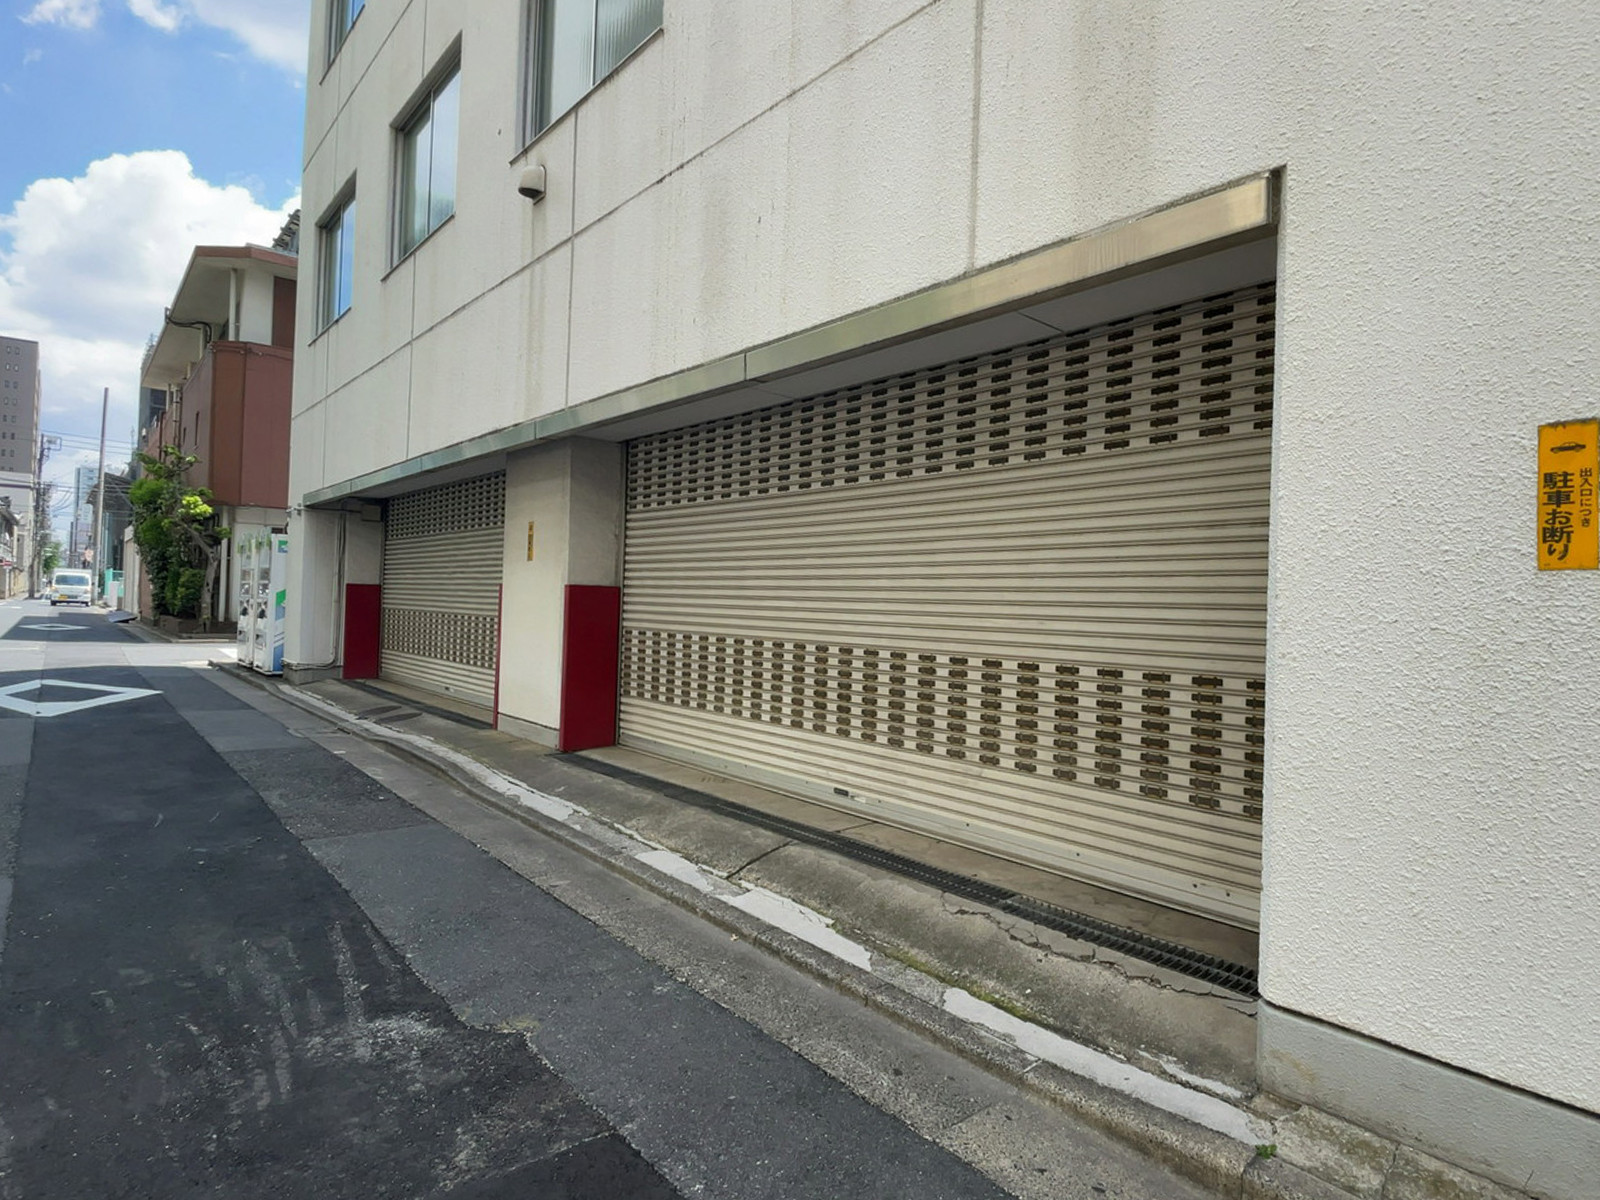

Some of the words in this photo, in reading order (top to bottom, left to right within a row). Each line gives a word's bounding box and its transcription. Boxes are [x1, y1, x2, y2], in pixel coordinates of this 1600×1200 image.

[1542, 471, 1575, 561] 駐車お断り
[1579, 467, 1593, 528] 出入口につき
